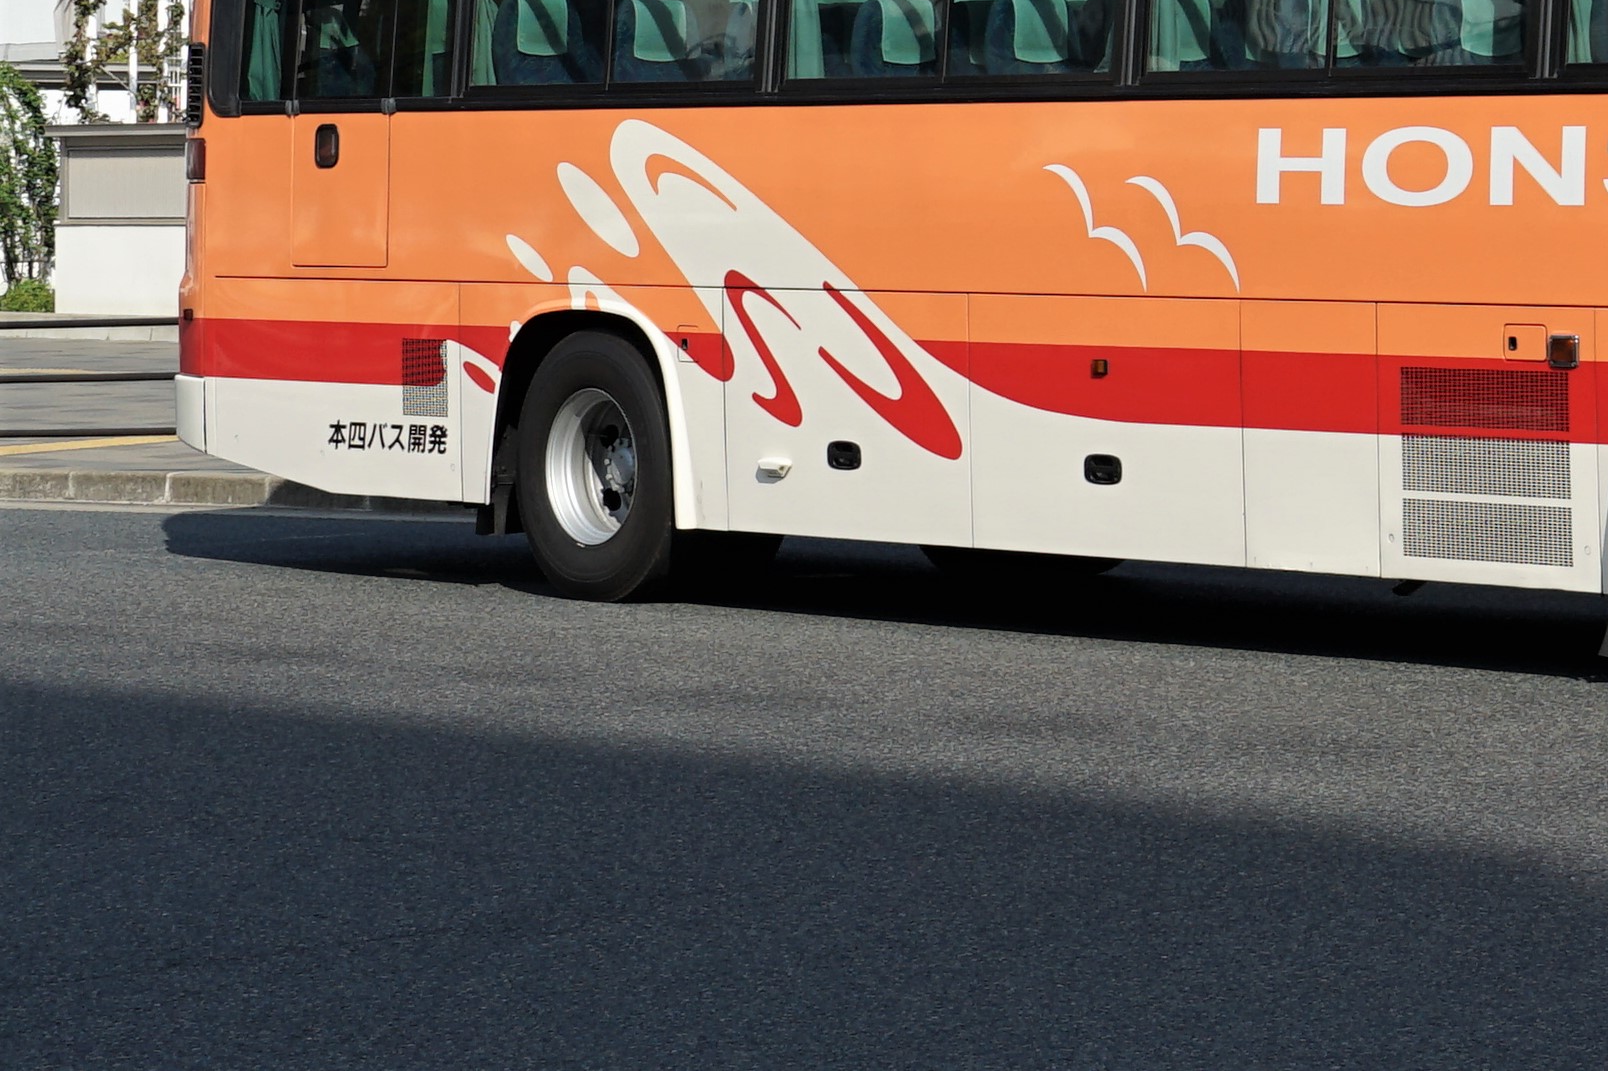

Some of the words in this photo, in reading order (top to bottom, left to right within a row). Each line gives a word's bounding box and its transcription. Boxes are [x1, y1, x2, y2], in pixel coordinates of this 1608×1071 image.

[328, 419, 448, 454] 本四バス開発
